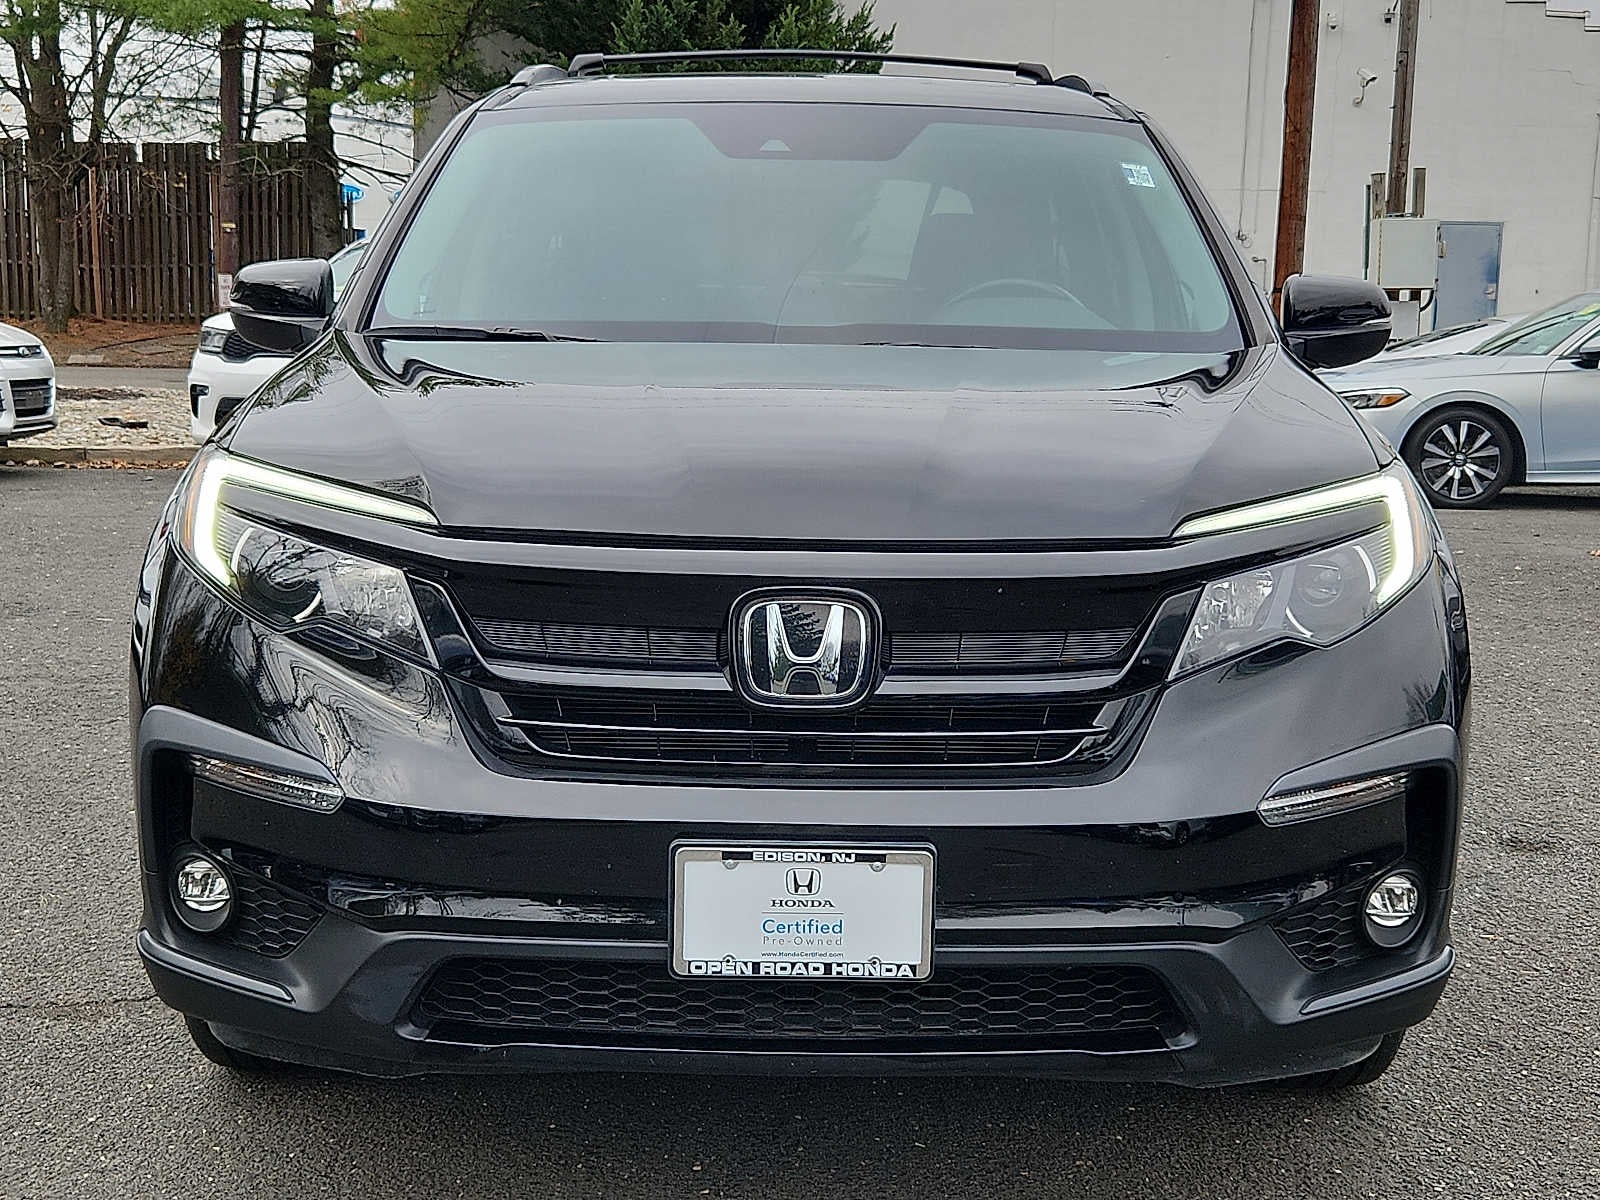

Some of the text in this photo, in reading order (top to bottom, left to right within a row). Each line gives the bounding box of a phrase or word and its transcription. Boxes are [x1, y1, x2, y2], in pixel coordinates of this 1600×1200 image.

[753, 851, 856, 863] EDISON, NJ
[770, 899, 836, 908] HONDA
[762, 919, 843, 935] Certified
[762, 935, 843, 946] Pre-Owned
[761, 951, 844, 959] www.HondaCertified.com
[689, 961, 914, 977] OPEN ROAD HONDA
